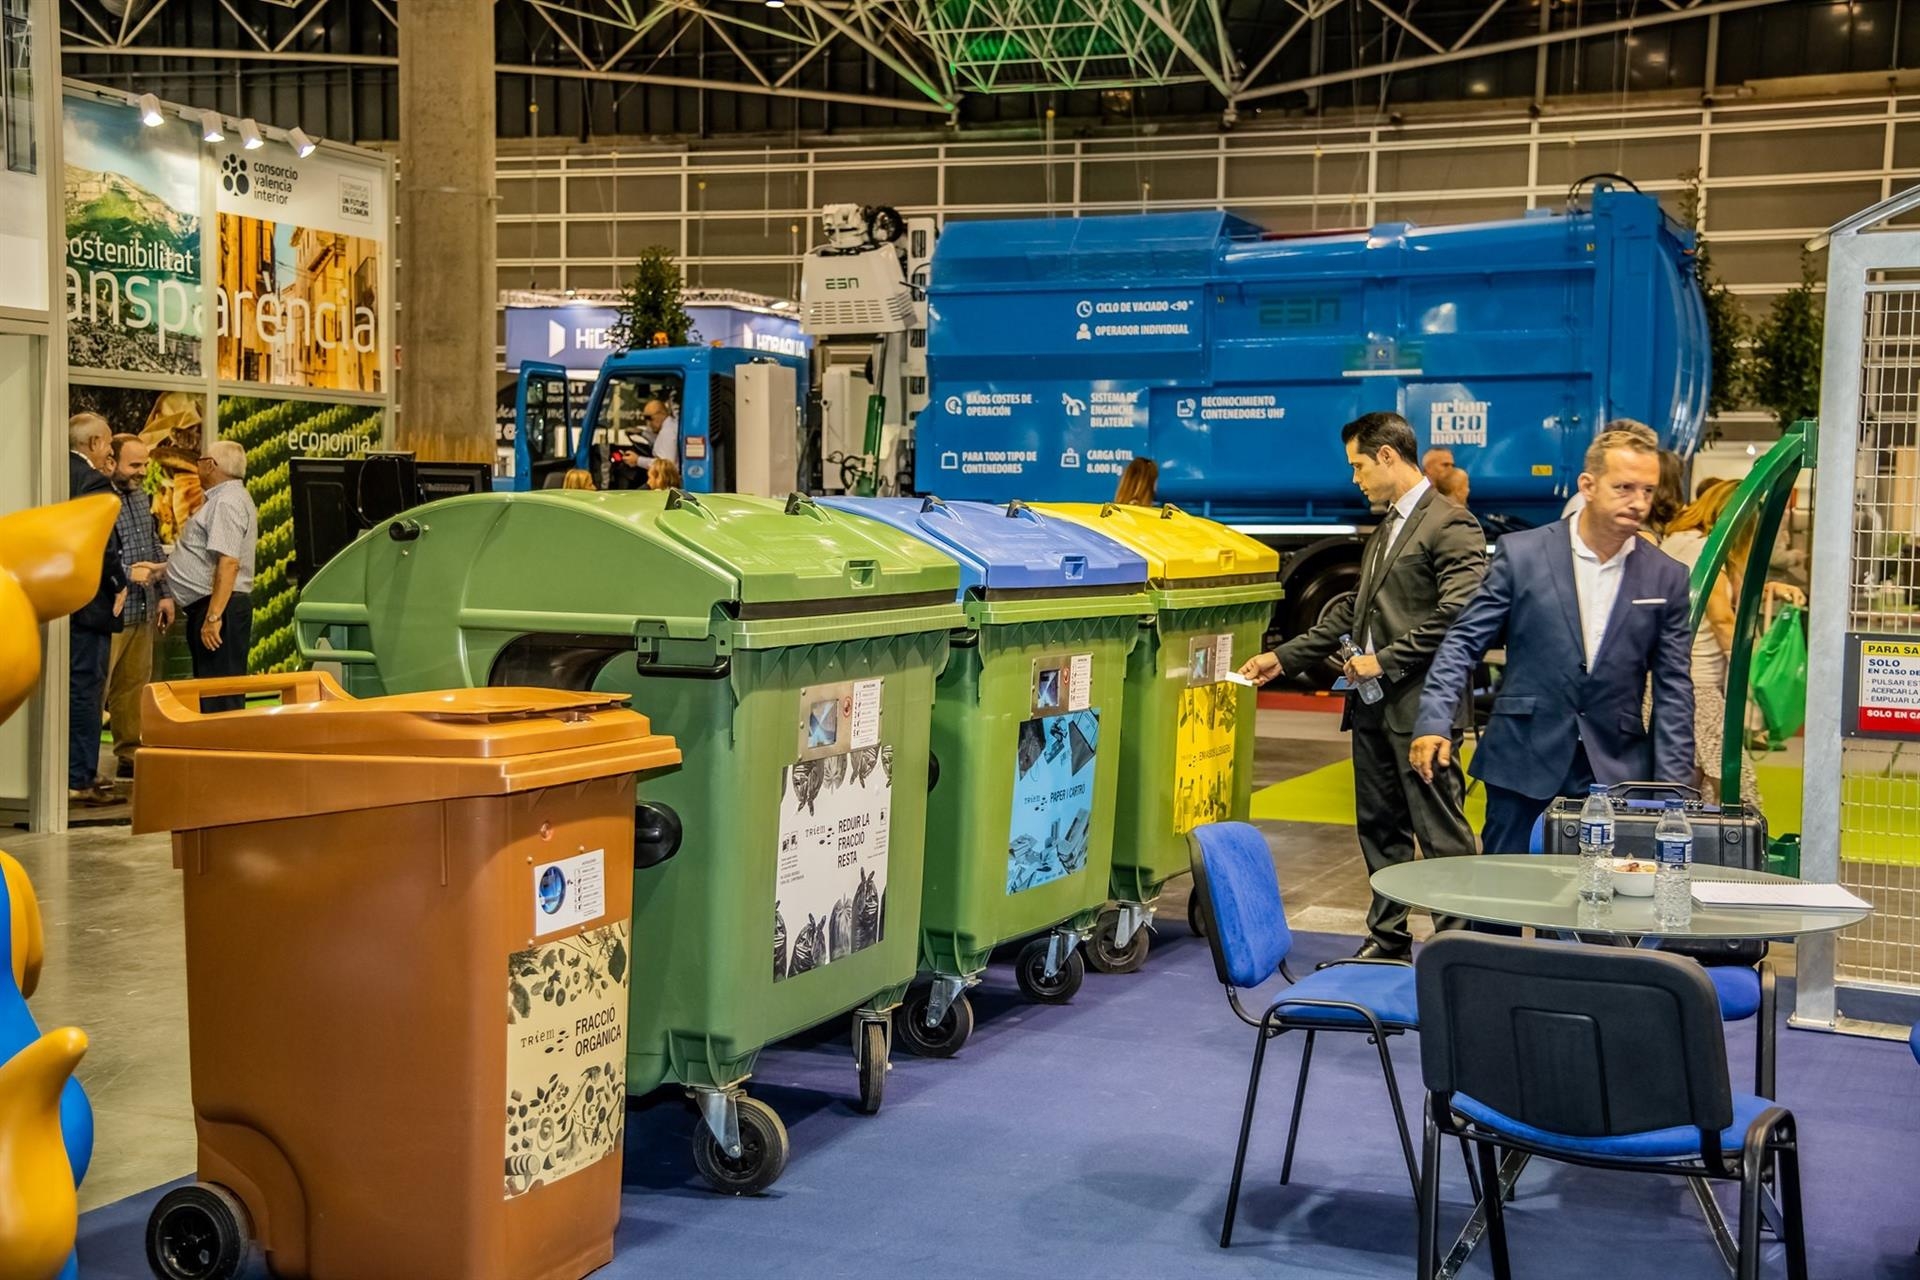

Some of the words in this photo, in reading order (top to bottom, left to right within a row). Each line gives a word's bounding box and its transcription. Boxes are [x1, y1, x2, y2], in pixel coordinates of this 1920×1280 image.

[254, 162, 298, 181] consorcio
[254, 175, 292, 193] valencia
[254, 186, 289, 205] interior
[1096, 302, 1119, 313] CICLO
[1120, 302, 1131, 312] DE
[1132, 301, 1169, 312] VACIADO
[1095, 324, 1140, 336] OPERADOR
[1141, 324, 1189, 335] INDIVIDUAL
[966, 394, 991, 404] BAJOS
[991, 394, 1020, 404] COSTES
[1021, 394, 1032, 404] DE
[1090, 392, 1125, 403] SISTEMA
[1201, 395, 1276, 407] RECONOCIMIENTO
[966, 405, 1011, 416] OPERACIÓN
[1090, 405, 1135, 415] ENGANCHE
[1201, 408, 1266, 419] CONTENEDORES
[1090, 417, 1134, 427] BILATERAL
[288, 431, 370, 452] economia
[962, 452, 983, 461] PARA
[984, 452, 1006, 461] TODO
[1007, 452, 1025, 461] TIPO
[1026, 451, 1037, 461] DE
[1087, 449, 1114, 460] CARGA
[1114, 448, 1134, 460] ÚTIL
[962, 463, 1023, 474] CONTENEDORES
[1087, 463, 1111, 473] 8.000
[1111, 463, 1123, 476] Kg
[1868, 645, 1900, 654] PARA
[1869, 658, 1900, 667] SOLO
[1882, 668, 1907, 676] CASO
[1871, 679, 1905, 687] PULSAR
[1871, 687, 1907, 695] ACERCAR
[1871, 696, 1909, 704] EMPUJAR
[1867, 710, 1892, 718] SOLO
[1894, 711, 1907, 719] EN
[1050, 789, 1066, 803] PAPER
[838, 815, 861, 834] REDUIR
[862, 813, 870, 827] LA
[837, 850, 858, 868] RESTA
[575, 1002, 616, 1037] FRACCIÓ
[575, 1023, 622, 1057] ORGÀNICA
